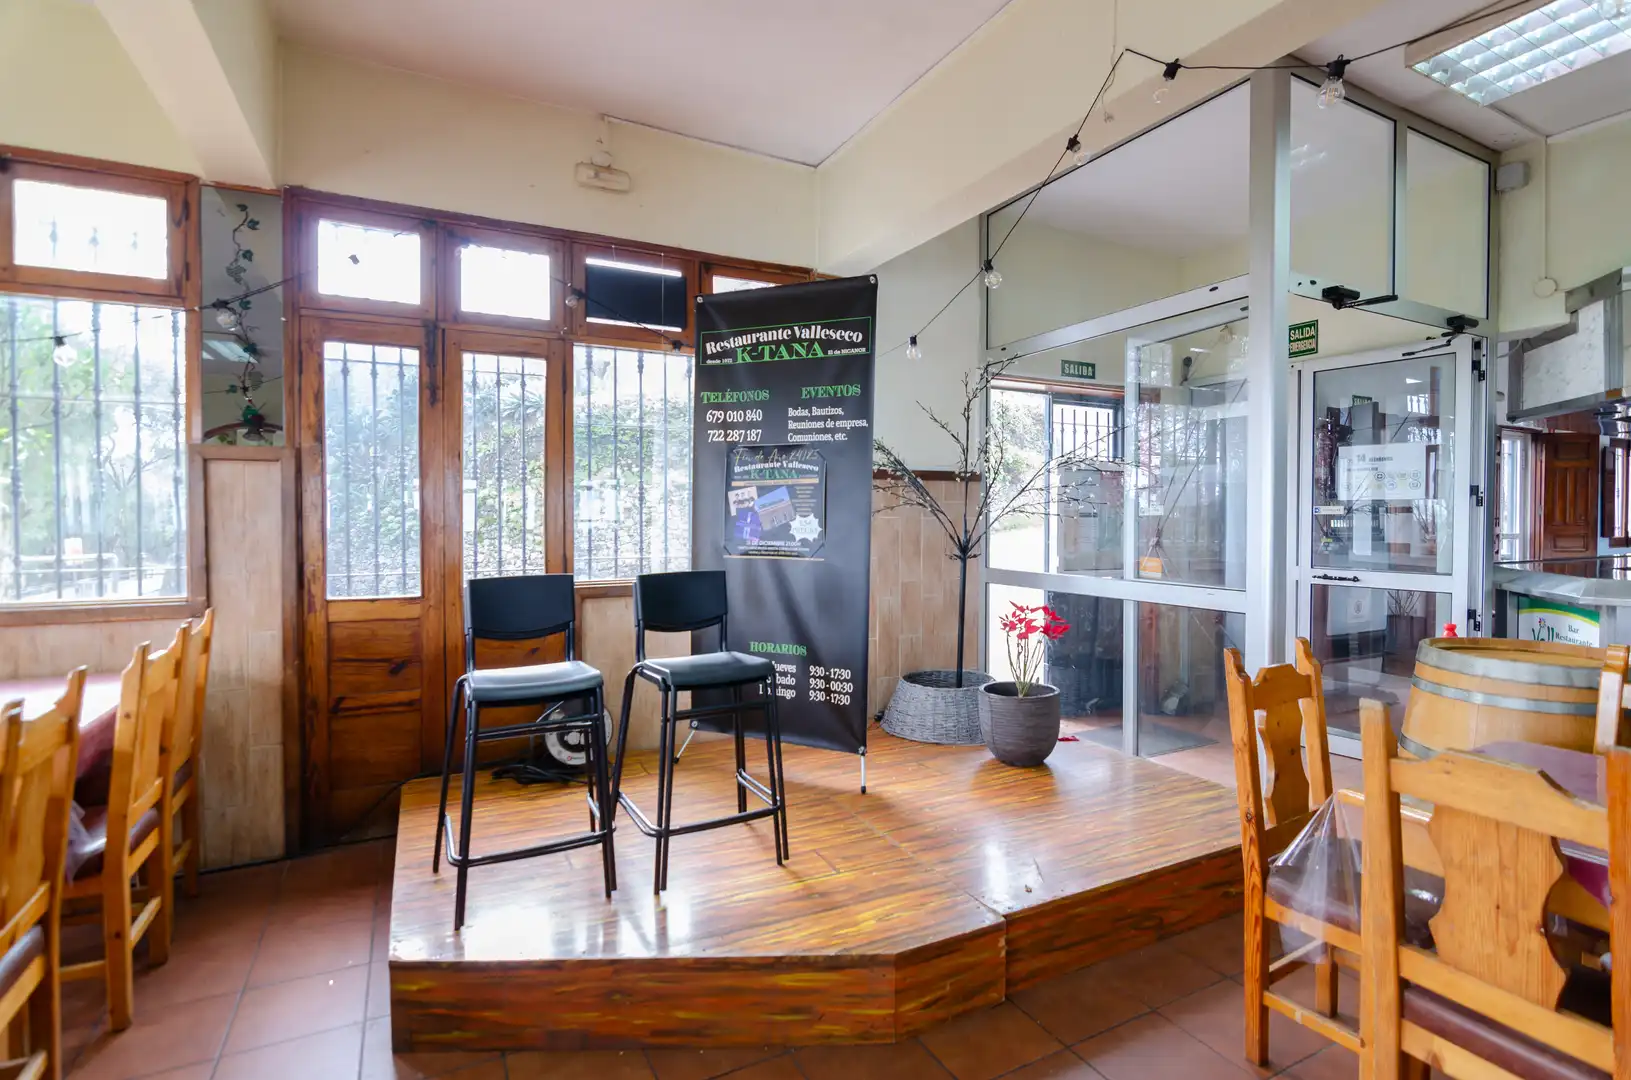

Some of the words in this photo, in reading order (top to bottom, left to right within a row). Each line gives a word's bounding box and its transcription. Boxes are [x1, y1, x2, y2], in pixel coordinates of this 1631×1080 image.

[706, 327, 792, 355] Restaurante
[793, 325, 863, 343] Valleseco
[1290, 326, 1315, 341] SALIDA
[736, 341, 824, 364] K-TANA
[1064, 363, 1093, 376] SALIDA
[700, 388, 770, 404] TELÉFONOS
[801, 384, 861, 399] EVENTOS
[706, 409, 725, 423] 679
[726, 410, 744, 422] 010
[745, 409, 763, 422] 840
[788, 407, 811, 417] Bodas,
[812, 405, 845, 416] Bautizos,
[788, 420, 825, 430] Reuniones
[825, 418, 835, 428] de
[836, 419, 869, 430] empresa,
[708, 429, 725, 443] 722
[726, 429, 745, 443] 287
[746, 429, 762, 442] 187
[788, 432, 834, 442] Comuniones,
[834, 432, 848, 441] etc.
[734, 461, 781, 473] Restaurante
[1568, 625, 1579, 634] Bar
[749, 642, 807, 656] HORARIOS
[772, 661, 797, 673] ueves
[809, 665, 825, 677] 9:30
[830, 668, 851, 680] 17:30
[809, 678, 825, 689] 9:30
[830, 680, 854, 693] 00:30
[809, 690, 826, 702] 9:30
[830, 693, 850, 706] 17:30
